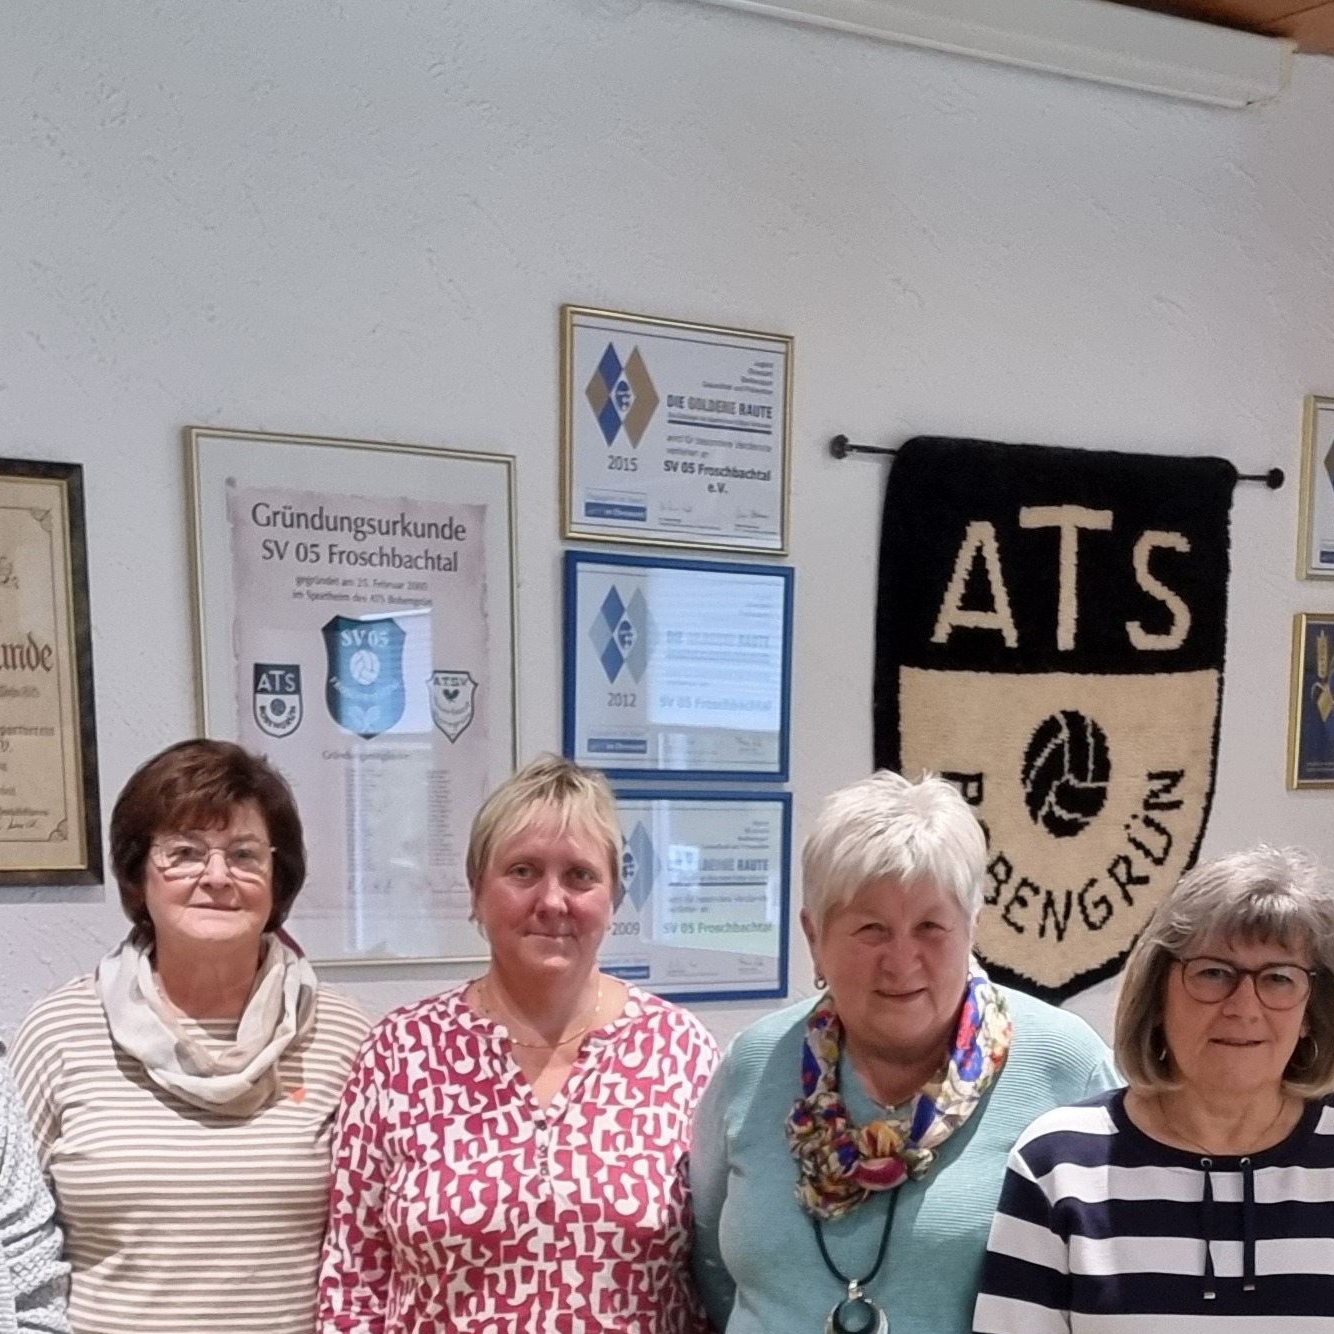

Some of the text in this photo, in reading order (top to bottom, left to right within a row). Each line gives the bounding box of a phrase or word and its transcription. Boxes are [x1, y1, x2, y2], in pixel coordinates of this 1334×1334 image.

[738, 402, 774, 420] RAUTE
[607, 454, 639, 472] 2015
[663, 459, 679, 473] SV
[251, 502, 467, 542] Gründungsurkunde
[261, 539, 459, 573] SV 05 Froschbachtal
[929, 503, 1192, 652] ATS
[341, 629, 390, 647] SV 05
[256, 670, 297, 692] ATS
[606, 693, 637, 708] 2012
